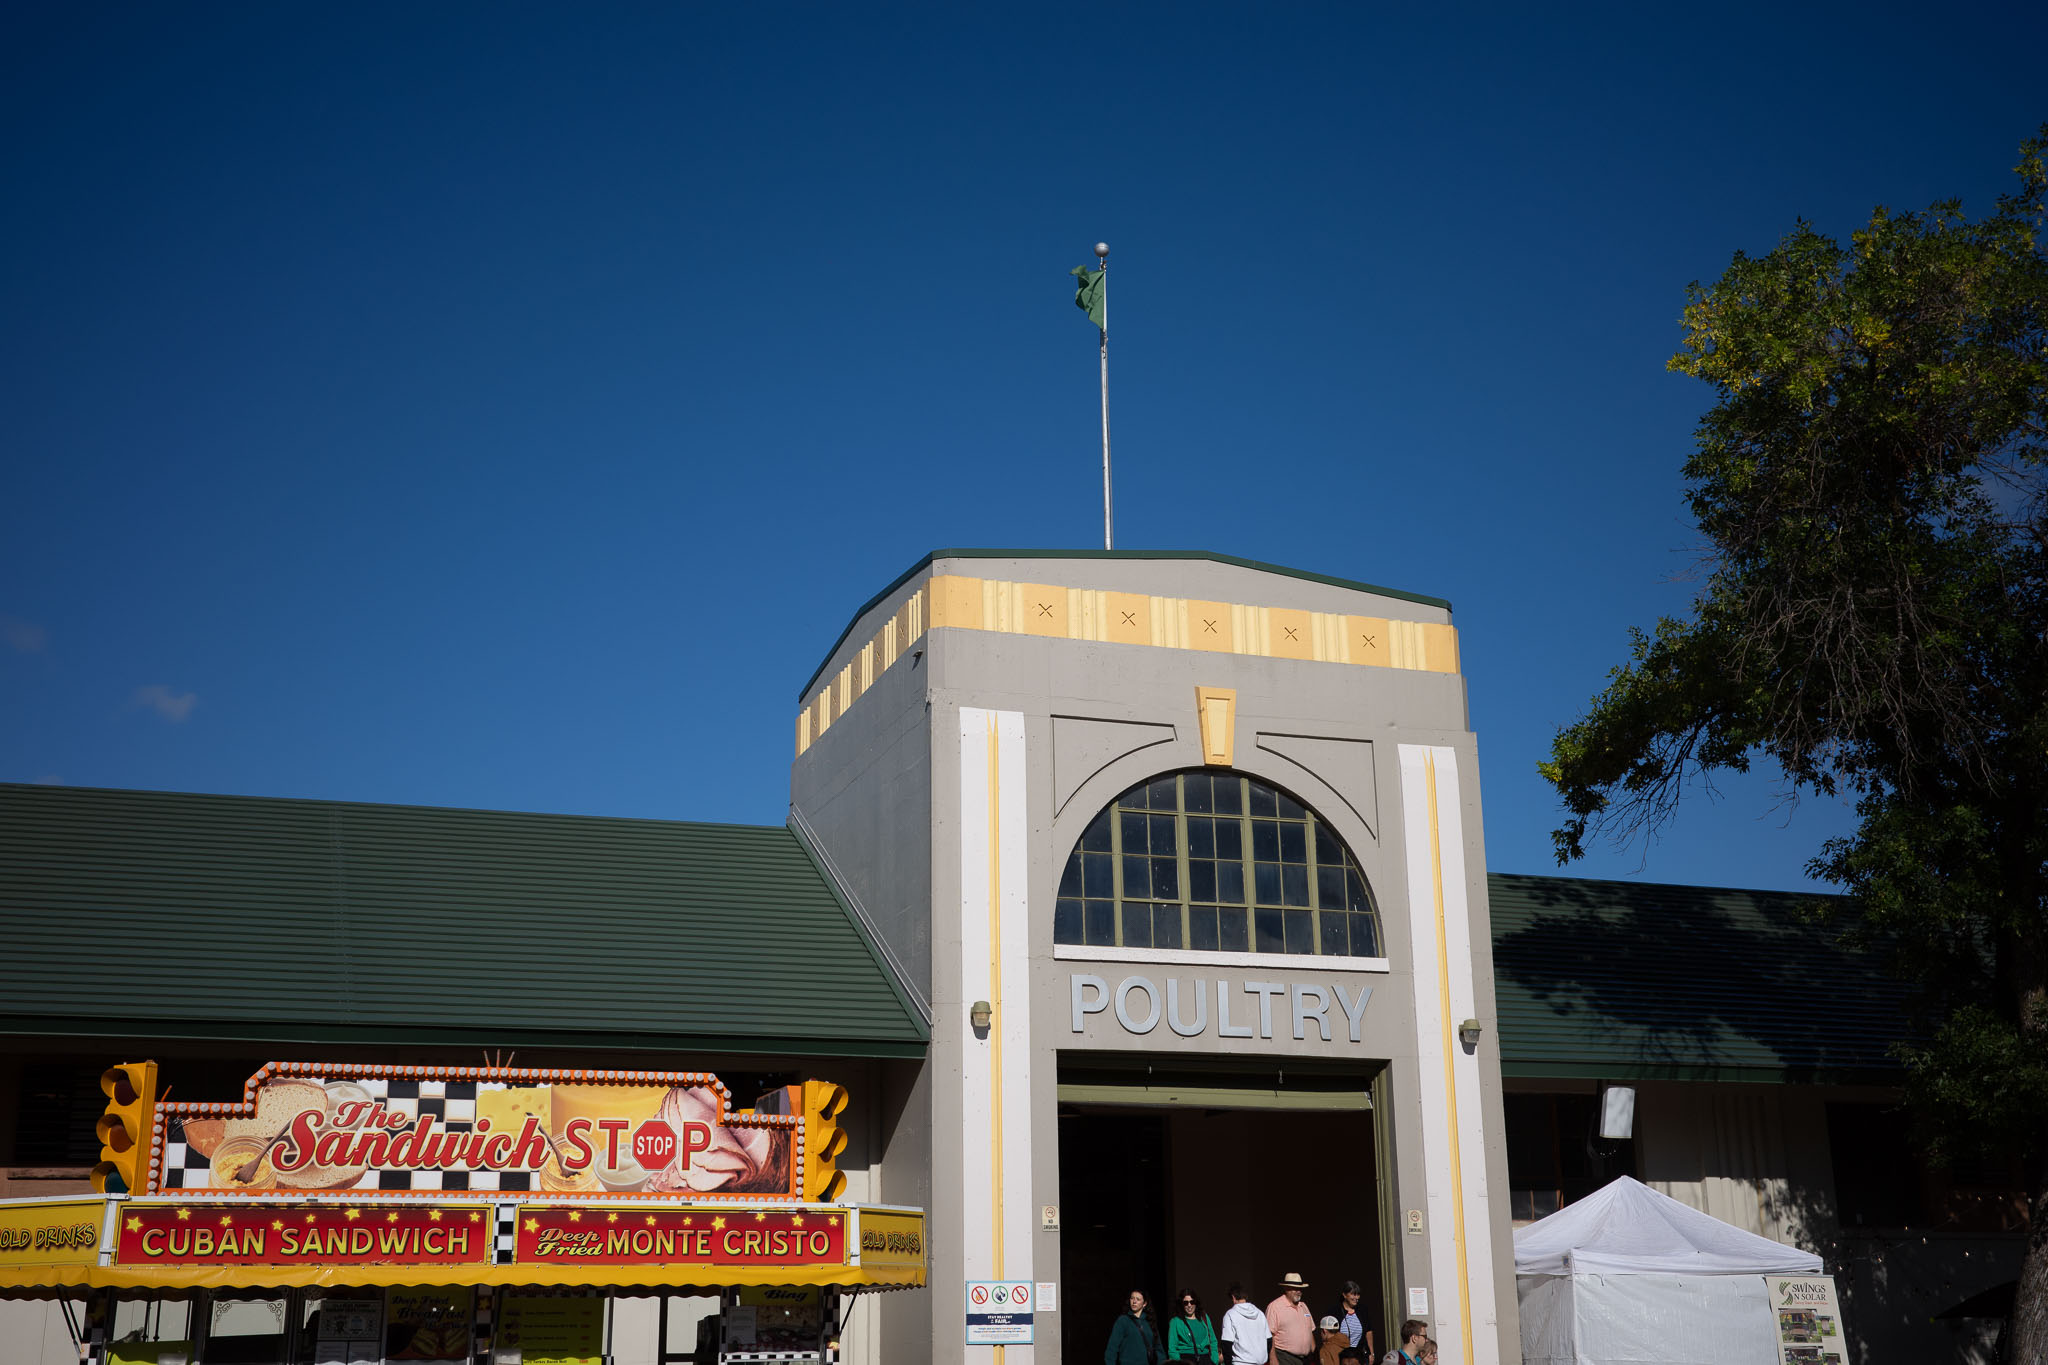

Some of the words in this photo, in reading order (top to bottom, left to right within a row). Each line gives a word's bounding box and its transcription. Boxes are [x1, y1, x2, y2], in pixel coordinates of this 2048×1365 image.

[1070, 974, 1373, 1042] POULTRY
[333, 1101, 407, 1128] The
[272, 1109, 550, 1171] Sandwich
[637, 1135, 673, 1156] STOP
[0, 1227, 31, 1248] OLD
[35, 1223, 96, 1248] DRINKS
[141, 1228, 266, 1256] CUBAN
[280, 1228, 469, 1255] SANDWICH
[538, 1228, 600, 1246] Deep
[607, 1229, 713, 1256] MONTE
[723, 1229, 830, 1256] CRISTO
[862, 1230, 885, 1249] COLD
[887, 1231, 920, 1252] DRINKS
[534, 1242, 604, 1256] Fried
[763, 1289, 808, 1302] Bing
[1792, 1282, 1826, 1293] SWINGS
[1801, 1293, 1826, 1301] SOLAR
